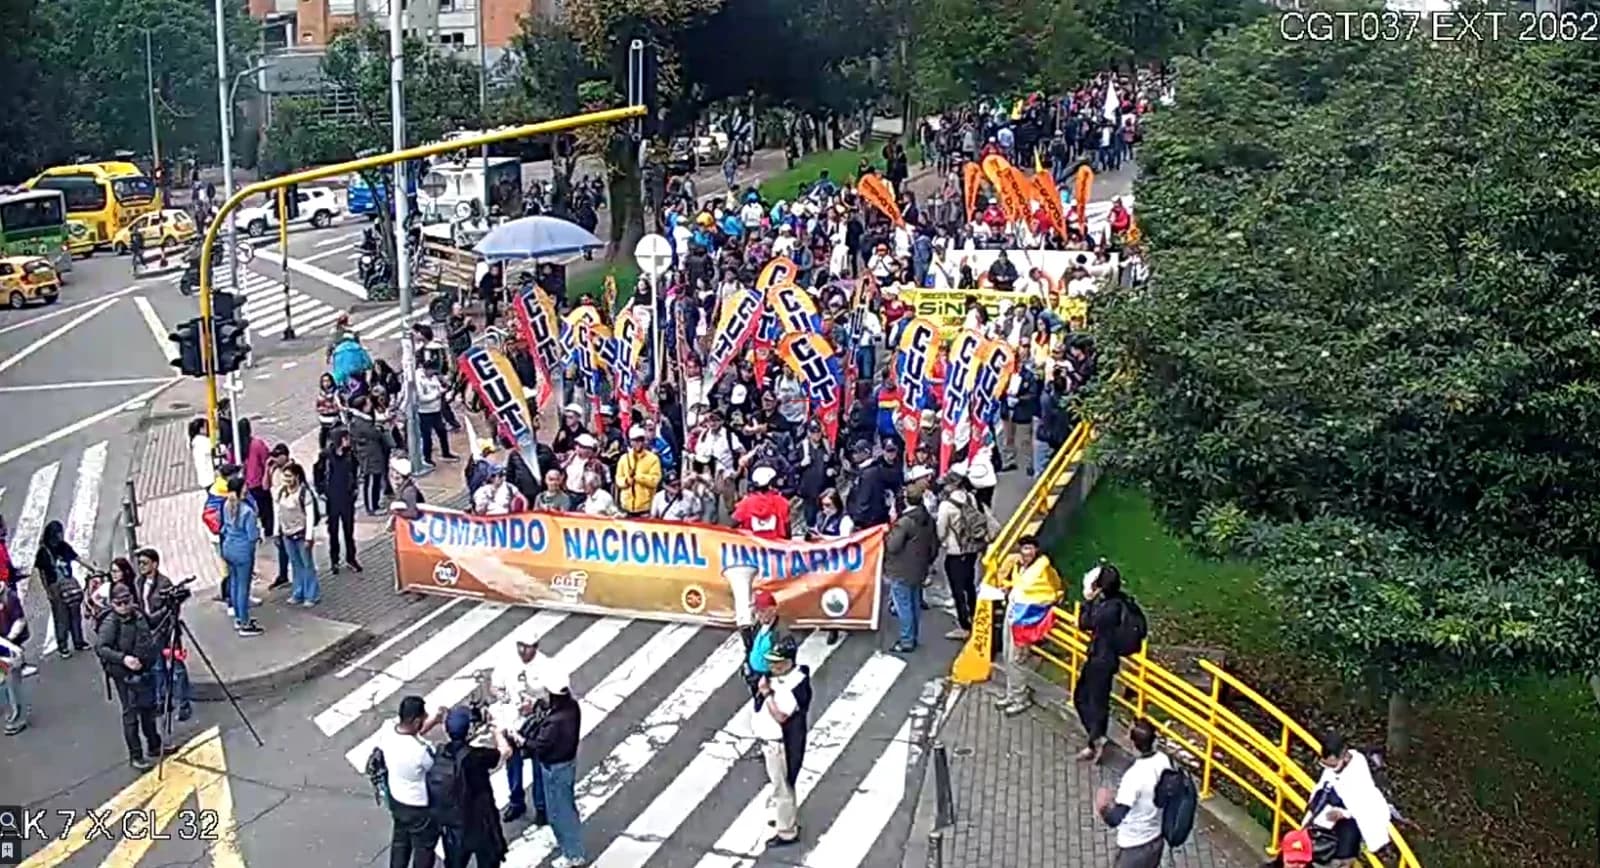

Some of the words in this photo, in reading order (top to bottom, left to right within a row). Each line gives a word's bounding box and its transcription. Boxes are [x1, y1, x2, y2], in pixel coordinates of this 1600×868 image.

[522, 289, 559, 367] CUT
[713, 296, 757, 361] CUT
[780, 289, 812, 333] CU
[618, 318, 636, 391] CUT
[790, 337, 836, 404] CUT
[903, 325, 932, 409] CUT
[945, 335, 977, 424] CUT
[975, 350, 1007, 420] CUT
[471, 351, 528, 433] CUT
[408, 513, 547, 552] COMANDO
[563, 527, 707, 567] NACIONAL
[720, 542, 863, 579] UNITARIO
